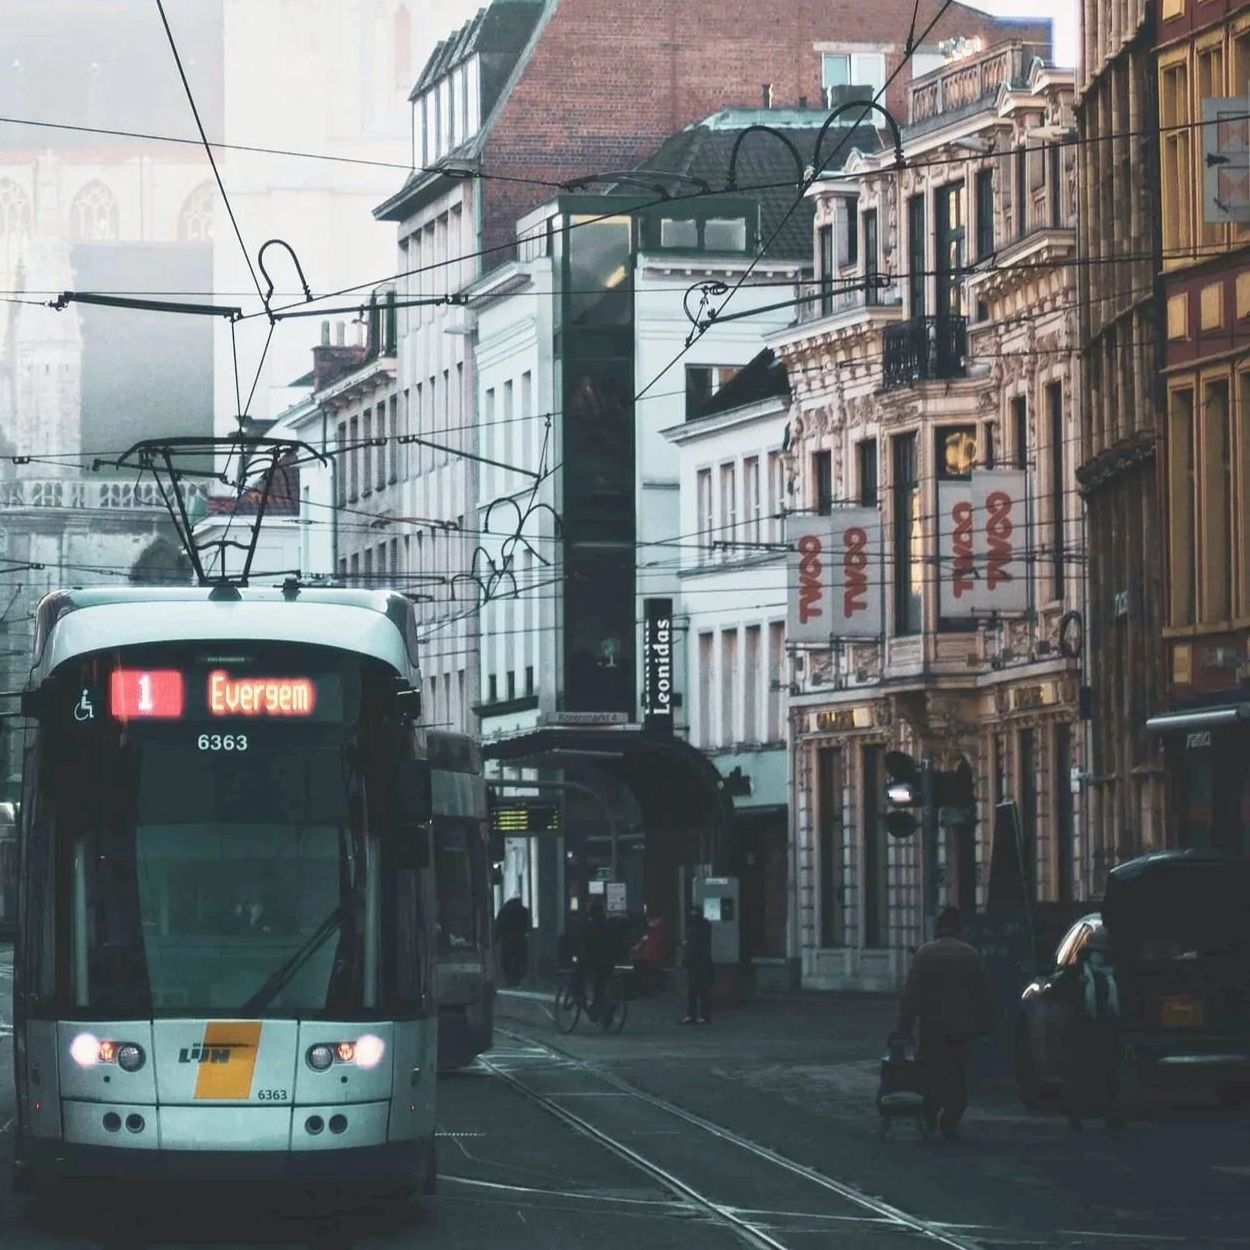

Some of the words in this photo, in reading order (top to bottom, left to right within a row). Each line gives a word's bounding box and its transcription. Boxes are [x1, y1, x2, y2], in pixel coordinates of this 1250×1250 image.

[653, 618, 670, 715] Leonidas
[137, 676, 152, 711] 1
[211, 674, 309, 713] Evergem
[197, 734, 248, 751] 6363
[258, 1089, 288, 1101] 6363
